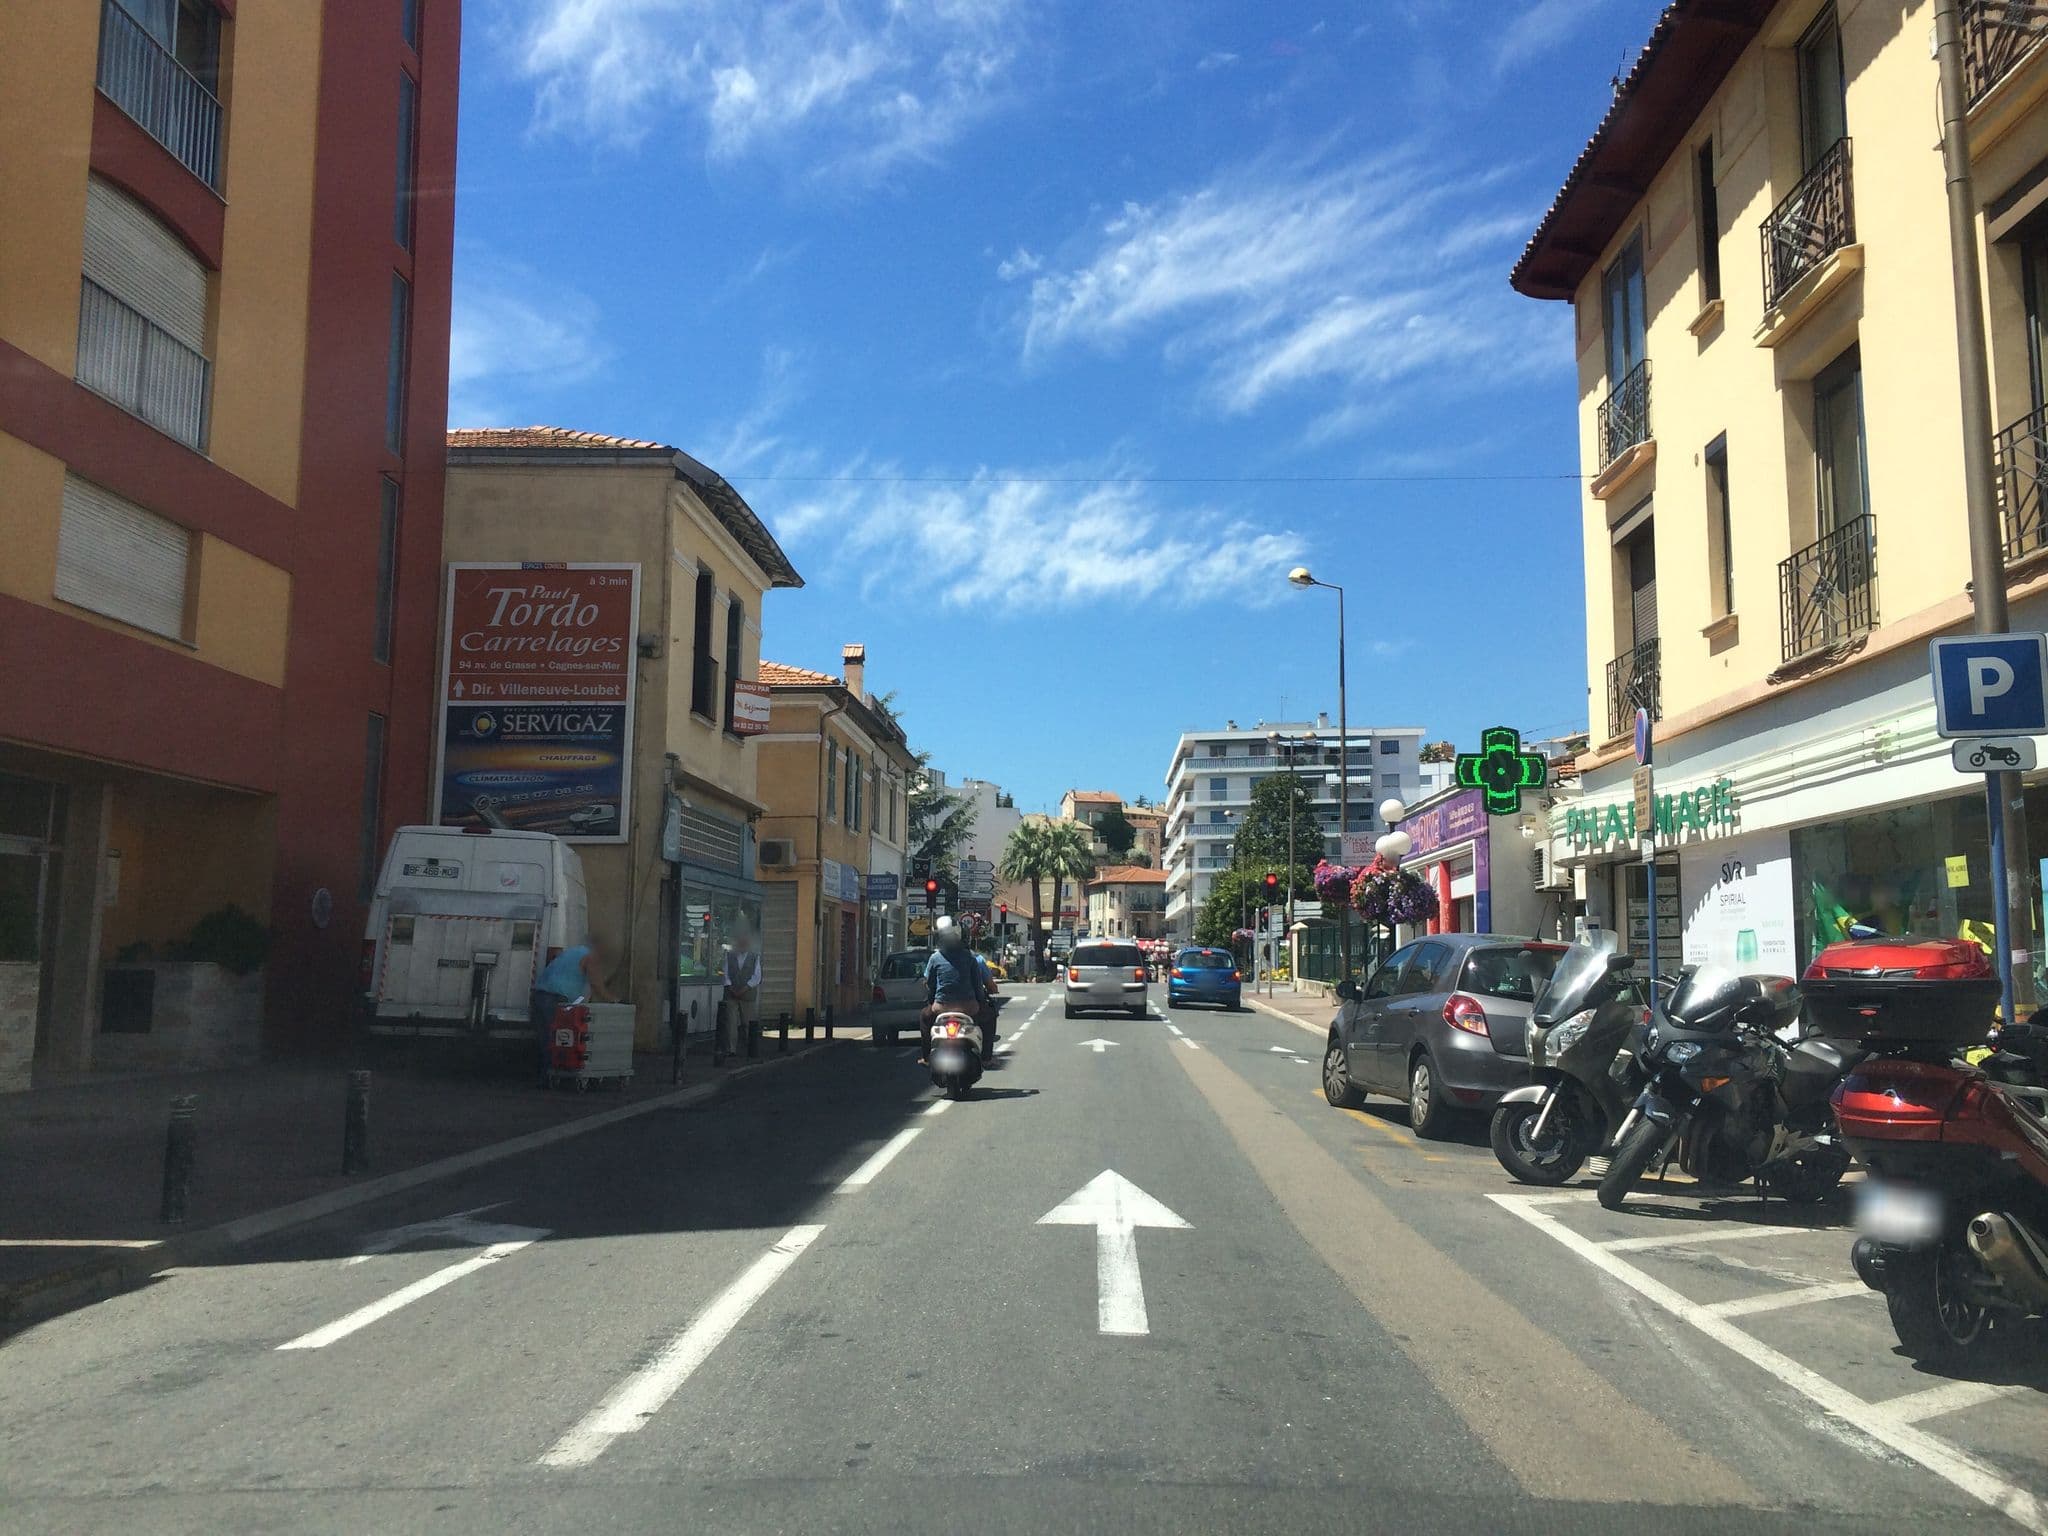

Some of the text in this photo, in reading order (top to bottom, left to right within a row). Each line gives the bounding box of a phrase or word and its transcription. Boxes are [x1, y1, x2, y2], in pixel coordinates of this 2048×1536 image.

[600, 576, 606, 587] 3
[609, 576, 629, 587] min
[530, 585, 571, 600] Paul
[486, 588, 600, 627] Tordo
[460, 631, 624, 657] Carrelages
[459, 661, 472, 670] 94
[491, 661, 502, 670] de
[505, 661, 537, 671] Grasse
[549, 661, 621, 672] Cagnes-sur-Mer
[472, 683, 622, 697] Dir. Villeneuve-Loubet
[1968, 657, 2015, 715] P
[503, 714, 614, 733] SERVIGAZ
[539, 754, 598, 762] CHAUFFAGE
[469, 775, 546, 784] CLIMATISATION
[1721, 860, 1743, 884] SVR
[1720, 892, 1747, 907] SPIRIAL
